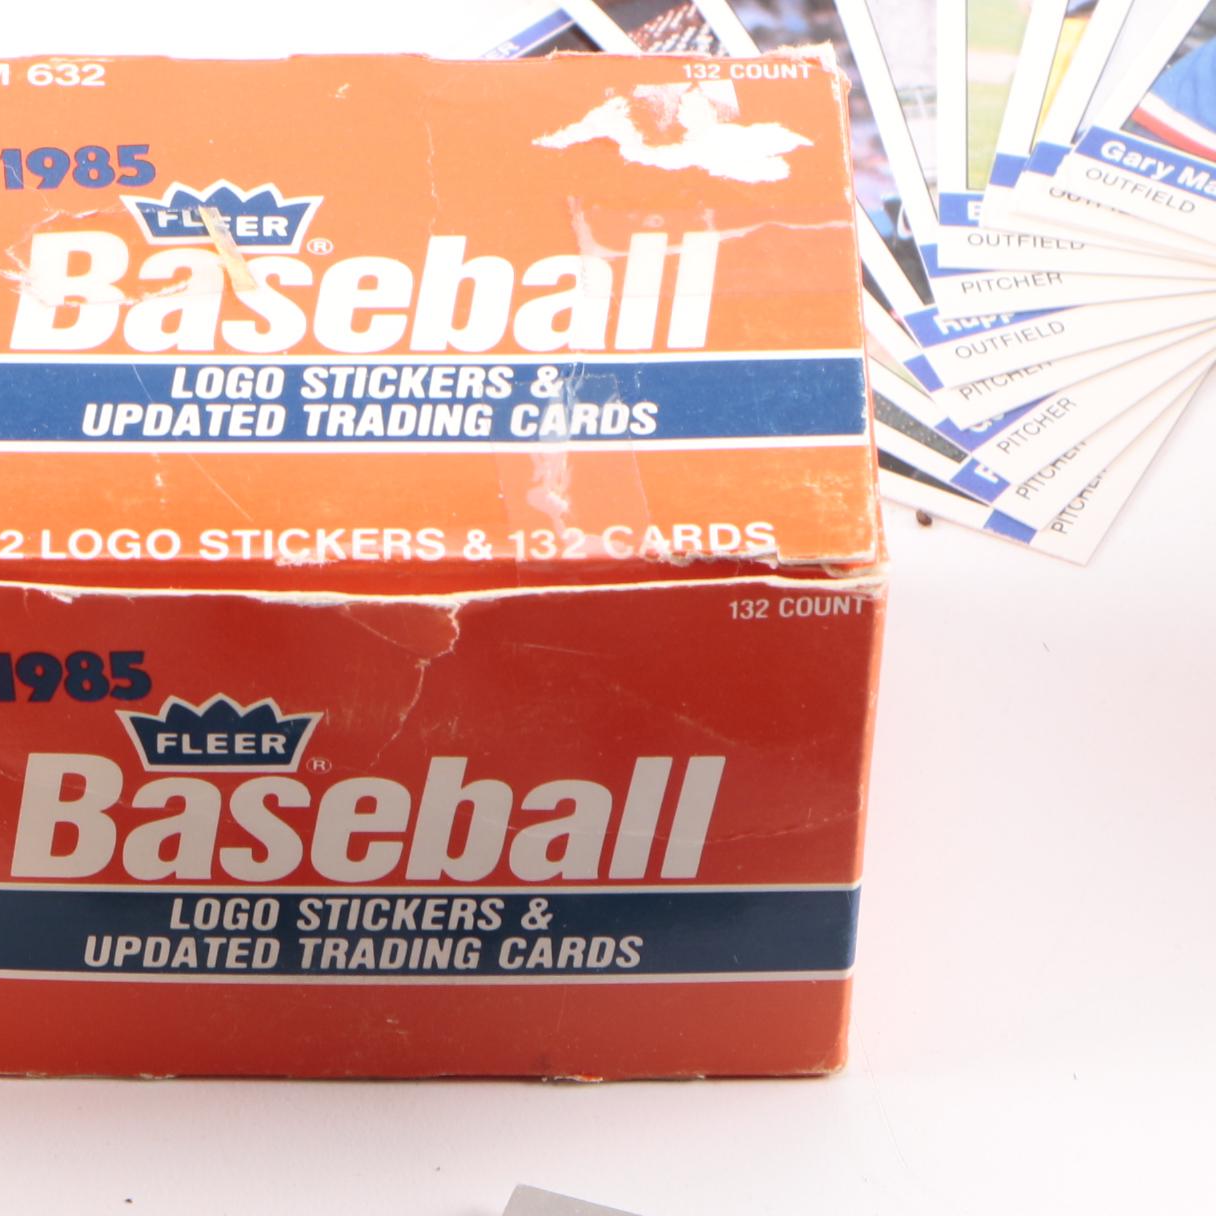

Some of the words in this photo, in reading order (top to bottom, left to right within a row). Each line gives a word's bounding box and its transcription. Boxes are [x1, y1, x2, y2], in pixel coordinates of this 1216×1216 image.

[27, 62, 107, 87] 632
[682, 63, 722, 80] 132
[729, 62, 813, 80] COUNT
[0, 143, 157, 191] 1985
[1100, 139, 1175, 182] Gary
[1085, 167, 1197, 215] OUTFIELD
[9, 228, 721, 355] Baseball
[961, 272, 1064, 295] PITCHER
[954, 320, 1066, 360] OUTFIELD
[170, 366, 286, 400] LOGO
[299, 365, 514, 400] STICKERS
[529, 365, 565, 399] &
[81, 403, 287, 437] UPDATED
[302, 402, 493, 437] TRADING
[509, 401, 660, 437] CARDS
[996, 397, 1078, 455] PITCHER
[40, 528, 182, 561] LOGO
[198, 528, 446, 561] STICKERS
[462, 529, 494, 561] &
[508, 529, 586, 561] 132
[601, 520, 777, 560] CARDS
[729, 598, 770, 619] 132
[778, 594, 866, 618] COUNT
[156, 733, 287, 755] FLEER
[10, 752, 727, 883] Baseball
[169, 897, 281, 931] LOGO
[295, 897, 506, 932] STICKERS
[520, 897, 554, 931] &
[83, 935, 282, 970] UPDATED
[297, 936, 483, 970] TRADING
[497, 935, 644, 970] CARDS
